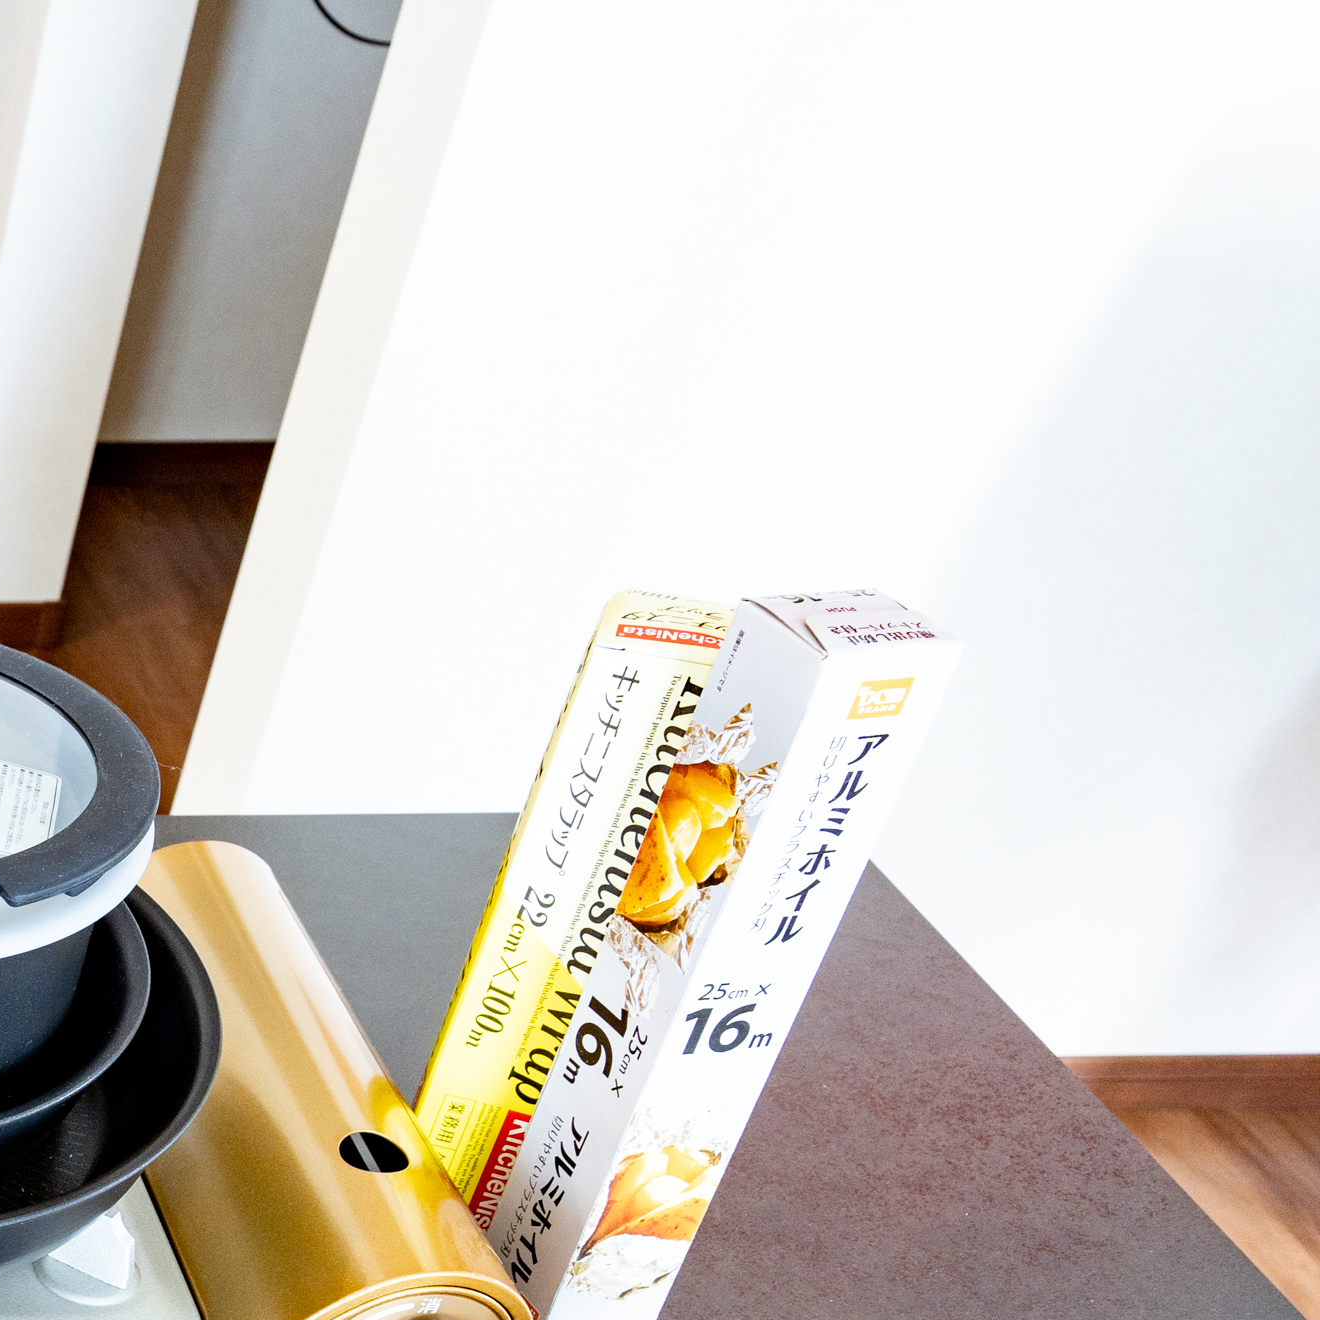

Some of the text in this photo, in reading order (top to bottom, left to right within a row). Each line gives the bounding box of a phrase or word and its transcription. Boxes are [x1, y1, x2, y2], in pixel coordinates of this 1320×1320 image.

[621, 611, 729, 632] ッチニスタ
[622, 627, 724, 647] tcheNista
[653, 685, 674, 721] support
[857, 704, 897, 714] BRAND
[641, 721, 660, 751] people
[545, 666, 640, 876] キッチニスタラップ
[632, 761, 644, 777] the
[617, 776, 638, 812] kitchen,
[610, 812, 622, 828] and
[748, 735, 848, 933] 切りやすいプラスチック刃
[765, 734, 889, 946] アルミホイル
[597, 838, 612, 858] help
[589, 858, 604, 880] them
[580, 879, 595, 902] shine
[567, 902, 585, 933] further.
[558, 933, 572, 955] That
[547, 960, 561, 981] what
[529, 980, 553, 1025] KitcheNista
[519, 1023, 535, 1046] hopes
[562, 995, 628, 1085] 16m
[681, 1004, 773, 1056] 16m
[515, 1046, 526, 1060] for.
[436, 1100, 466, 1144] 業務用
[474, 1119, 531, 1231] KitcheNis
[511, 1116, 590, 1284] アルミホイル
[416, 1298, 443, 1314] 消
